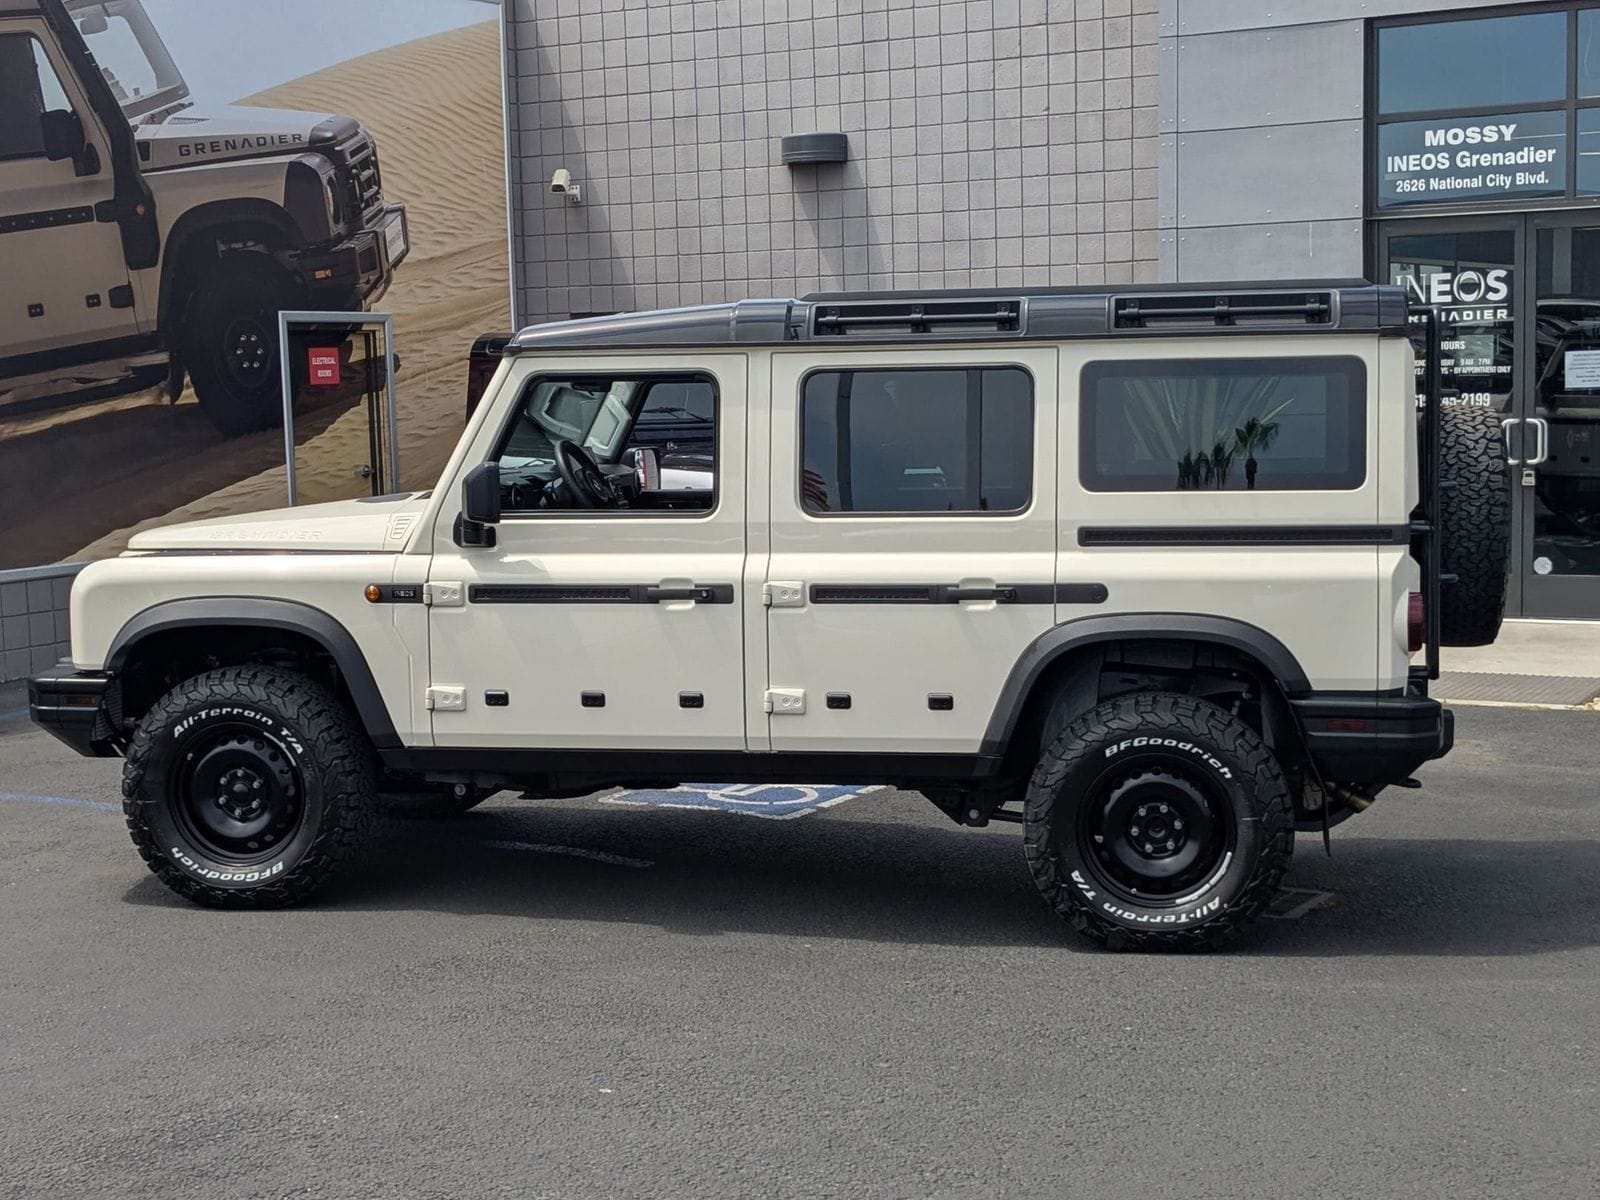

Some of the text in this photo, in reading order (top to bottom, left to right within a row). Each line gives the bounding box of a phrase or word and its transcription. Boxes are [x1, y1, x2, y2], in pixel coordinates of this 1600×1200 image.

[179, 133, 303, 157] GRENADIER
[1424, 124, 1517, 147] MOSSY
[1387, 147, 1557, 173] INEOS Grenadier
[1396, 171, 1549, 192] 2626 National City Blvd.
[173, 707, 304, 755] All-Terrain T/A
[1105, 736, 1233, 780] BFGoodrich
[171, 846, 284, 882] BFGoodrich
[1071, 869, 1220, 924] All-Terrain T/A
